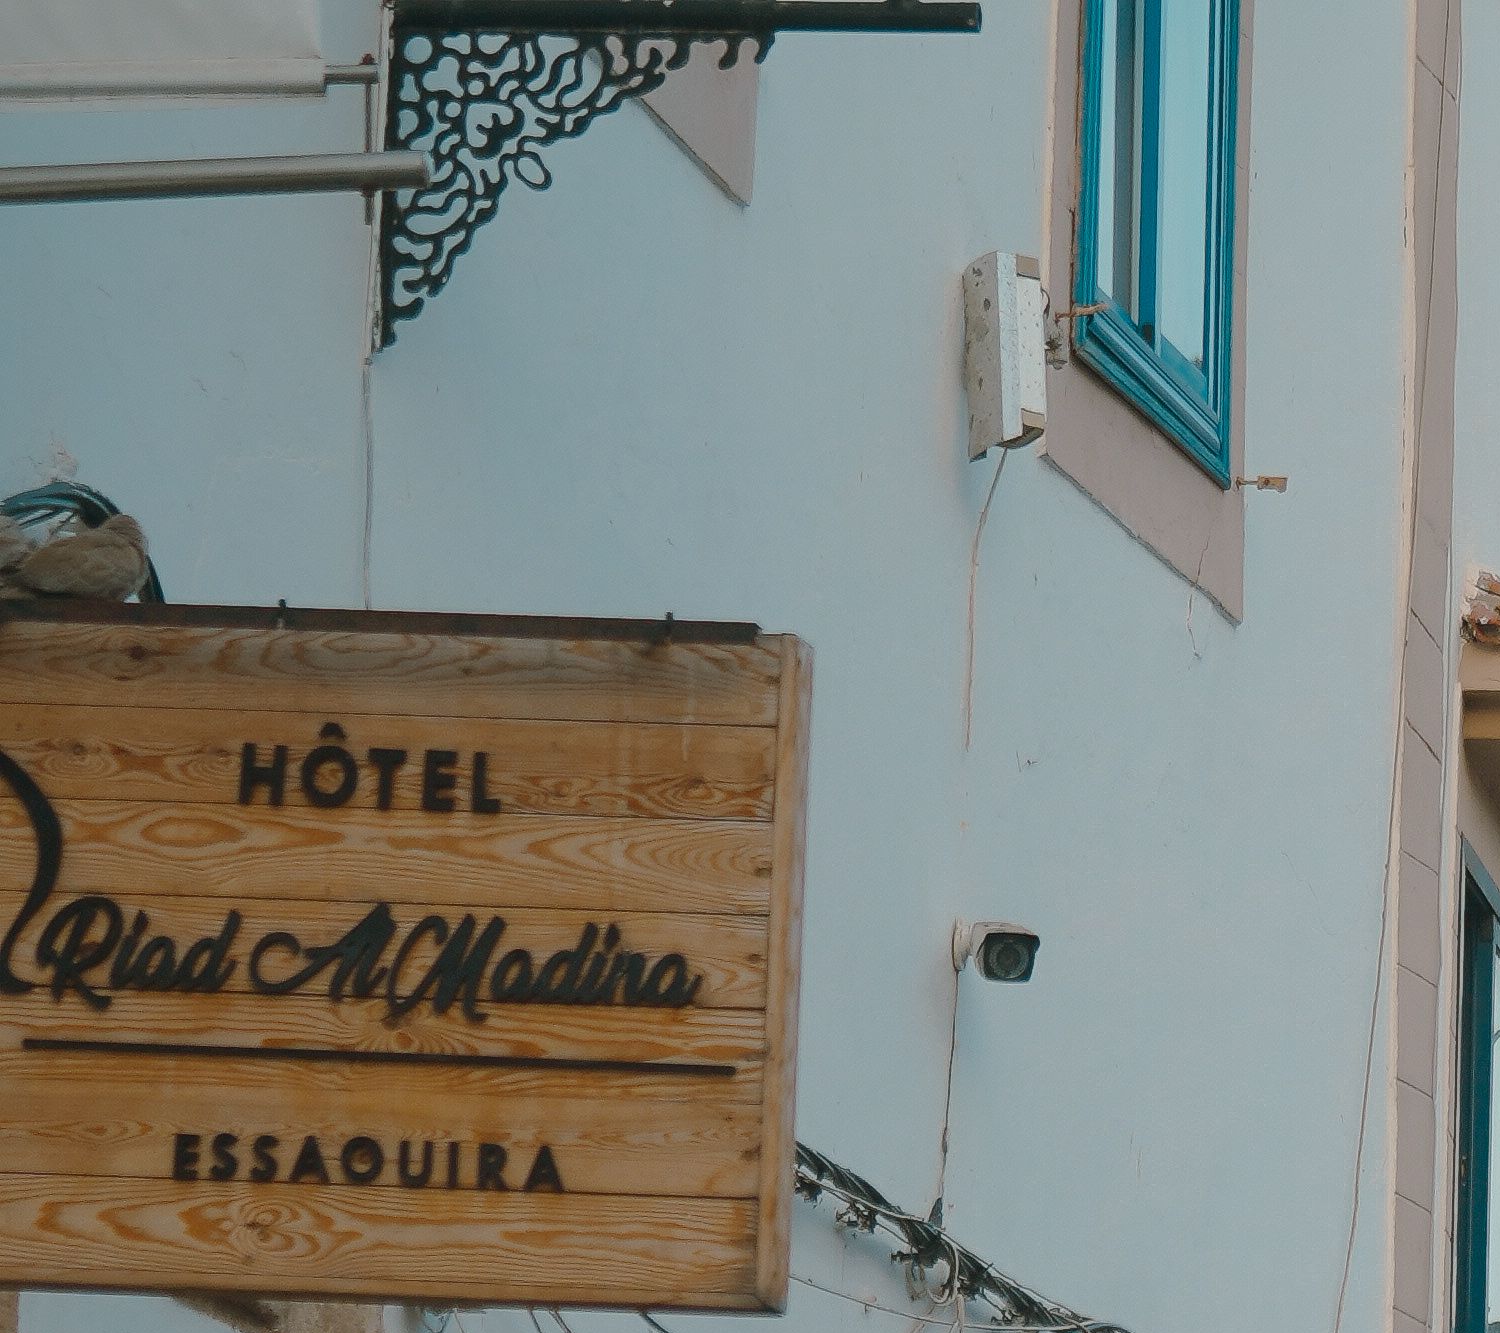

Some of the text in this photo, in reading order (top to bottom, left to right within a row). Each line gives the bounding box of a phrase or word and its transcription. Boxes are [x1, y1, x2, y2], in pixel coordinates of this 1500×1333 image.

[239, 722, 501, 815] HÔTEL
[36, 895, 703, 1025] Riad Al Madina
[172, 1132, 566, 1196] ESSAOUIRA
